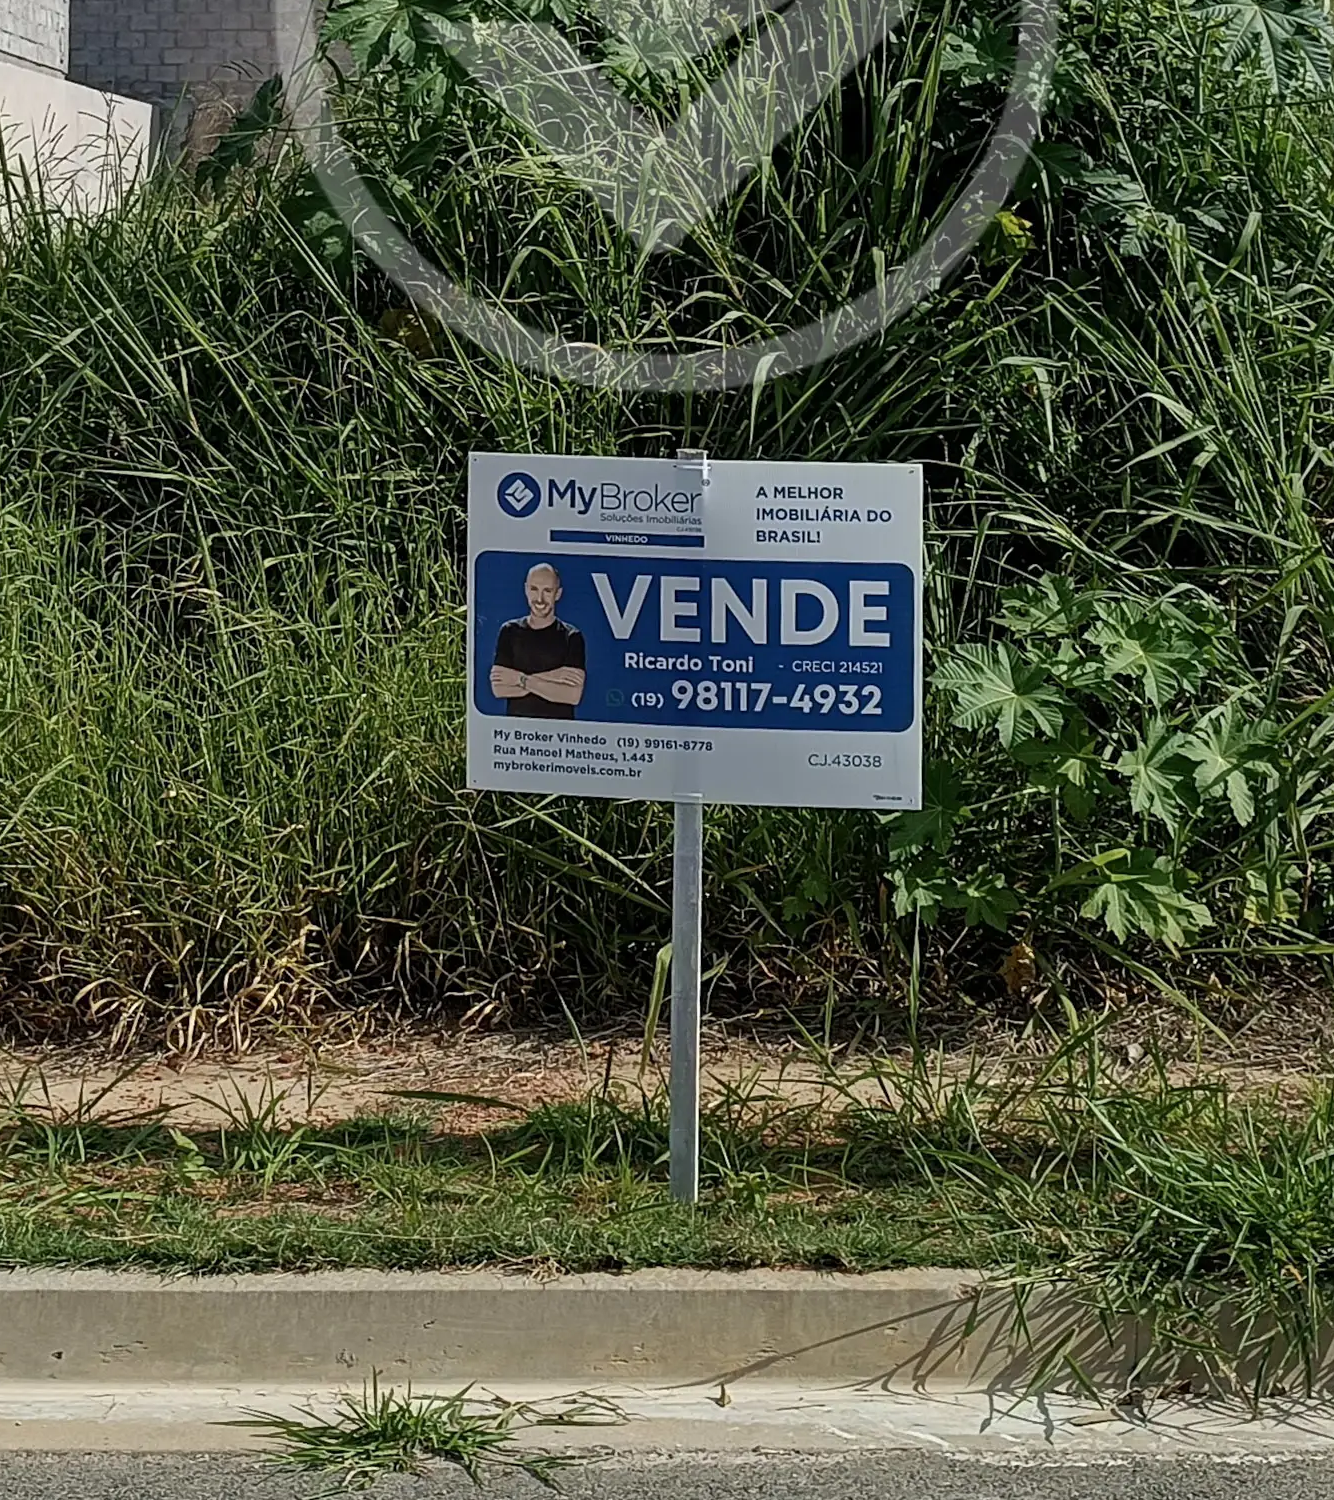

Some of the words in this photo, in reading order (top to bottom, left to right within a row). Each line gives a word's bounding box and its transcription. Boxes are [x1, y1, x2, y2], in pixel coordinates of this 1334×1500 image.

[548, 479, 702, 514] MyBroker
[756, 486, 768, 498] A
[773, 486, 843, 500] MELHOR
[600, 513, 643, 524] Soluções
[646, 514, 702, 525] Imobiliárias
[756, 506, 861, 522] IMOBILIÁRIA
[867, 510, 892, 522] DO
[605, 534, 648, 544] VINHEDO
[756, 530, 821, 543] BRASIL!
[591, 572, 891, 647] VENDE
[624, 652, 703, 671] Ricardo
[708, 655, 754, 673] Toni
[792, 660, 835, 672] CRECI
[839, 661, 883, 674] 214521
[631, 691, 664, 708] (19)
[671, 680, 883, 715] 98117-4932
[493, 730, 511, 741] My
[514, 730, 553, 742] Broker
[556, 733, 607, 745] Vinhedo
[617, 737, 640, 749] (19)
[644, 739, 713, 751] 99161-8778
[493, 745, 516, 755] Rua
[520, 746, 562, 758] Manoel
[565, 749, 618, 763] Matheus,
[622, 752, 654, 763] 1.443
[808, 753, 882, 768] CJ.43038
[493, 760, 642, 778] mybrokerimoveis.com.br
